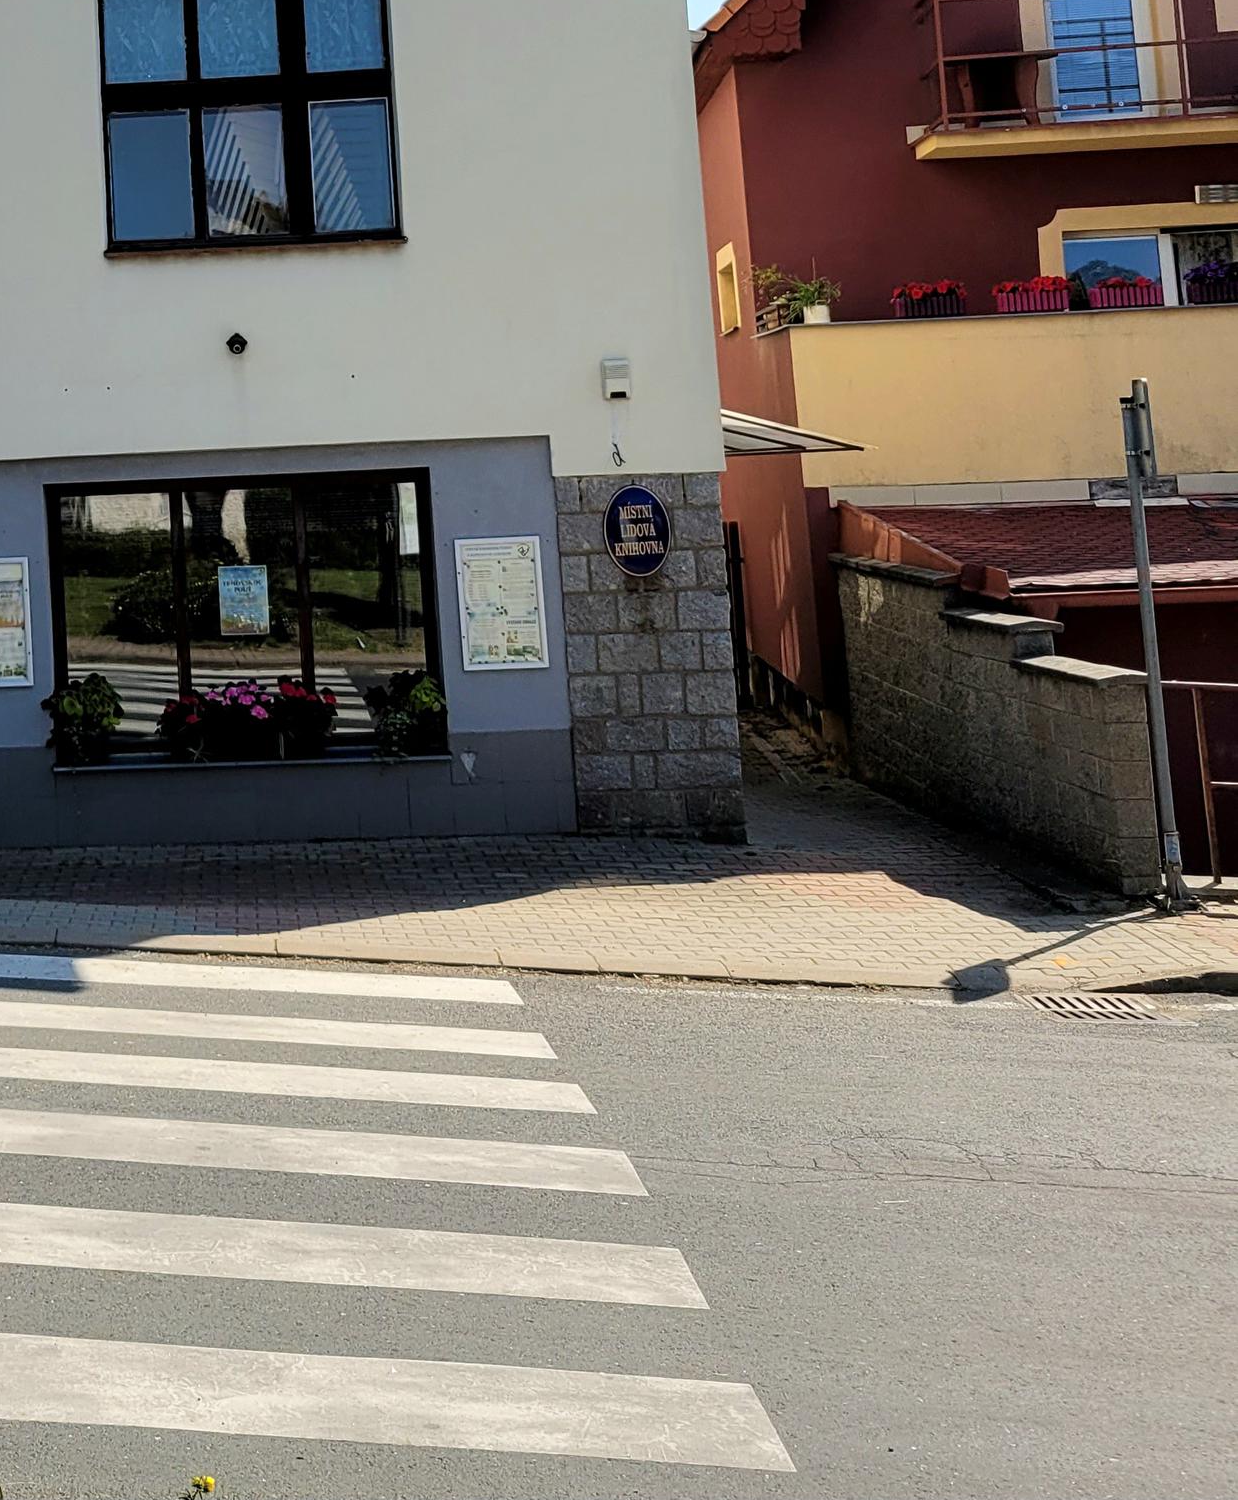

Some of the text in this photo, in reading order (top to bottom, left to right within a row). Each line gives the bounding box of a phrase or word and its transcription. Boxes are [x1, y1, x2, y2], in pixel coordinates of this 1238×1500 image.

[618, 500, 653, 519] MÍSTNÍ
[620, 519, 656, 538] LIDOVÁ
[614, 541, 664, 556] KNIHOVNA
